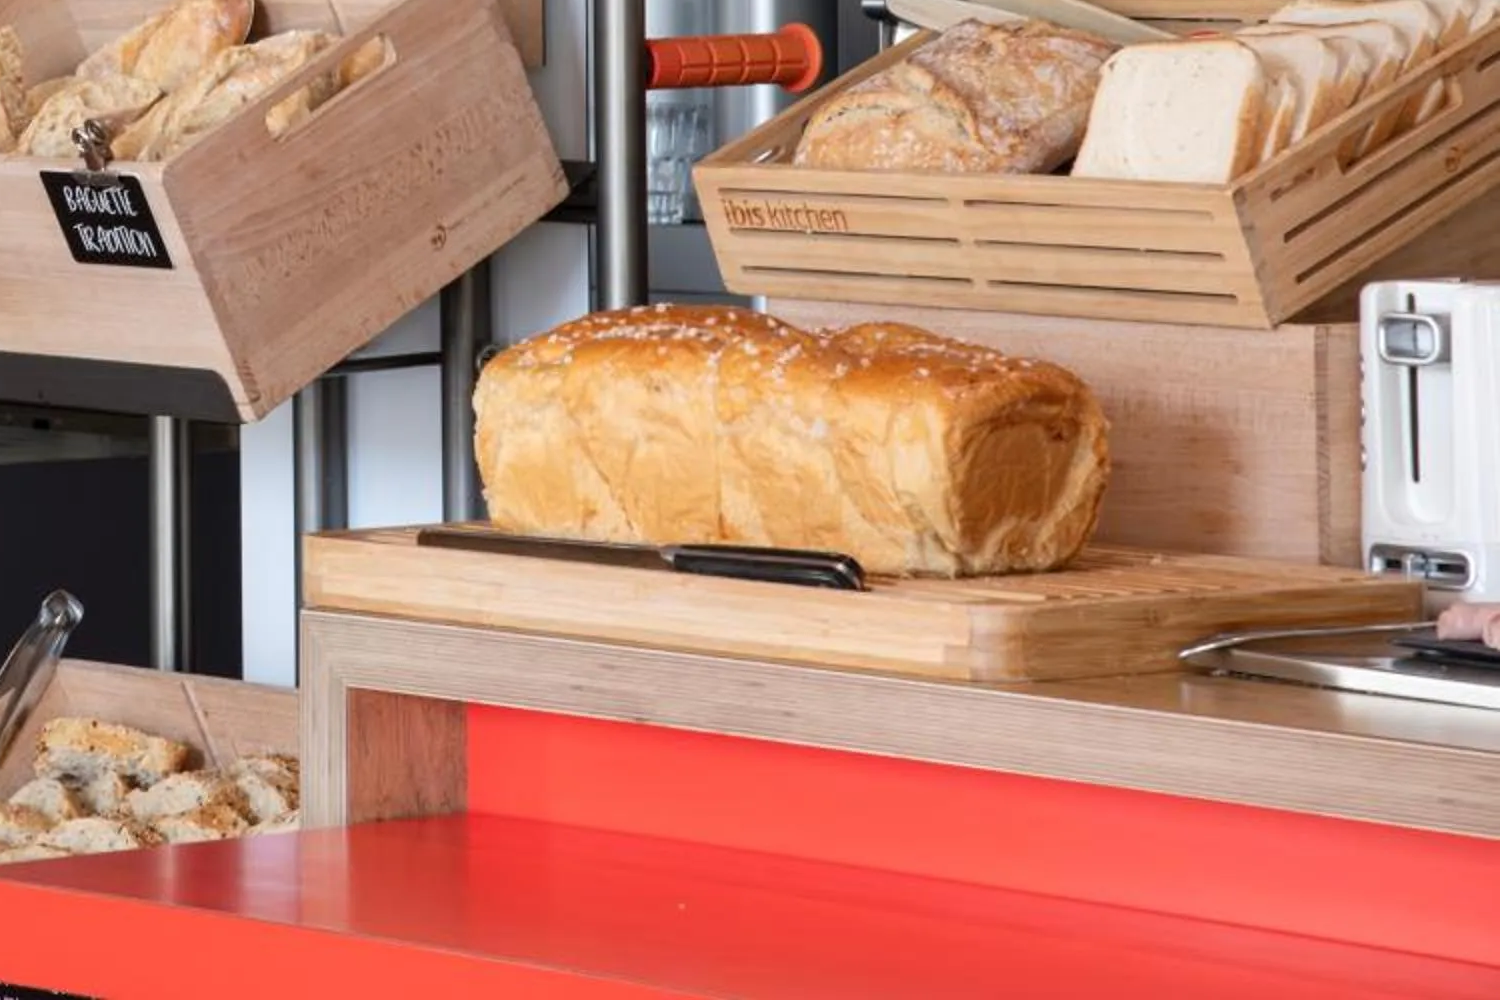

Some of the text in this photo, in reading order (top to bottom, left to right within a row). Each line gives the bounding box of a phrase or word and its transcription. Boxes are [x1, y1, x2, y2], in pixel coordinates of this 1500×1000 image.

[63, 185, 138, 217] BAGUETTE
[721, 200, 849, 231] ibis kitchen
[72, 223, 157, 257] TRADITION
